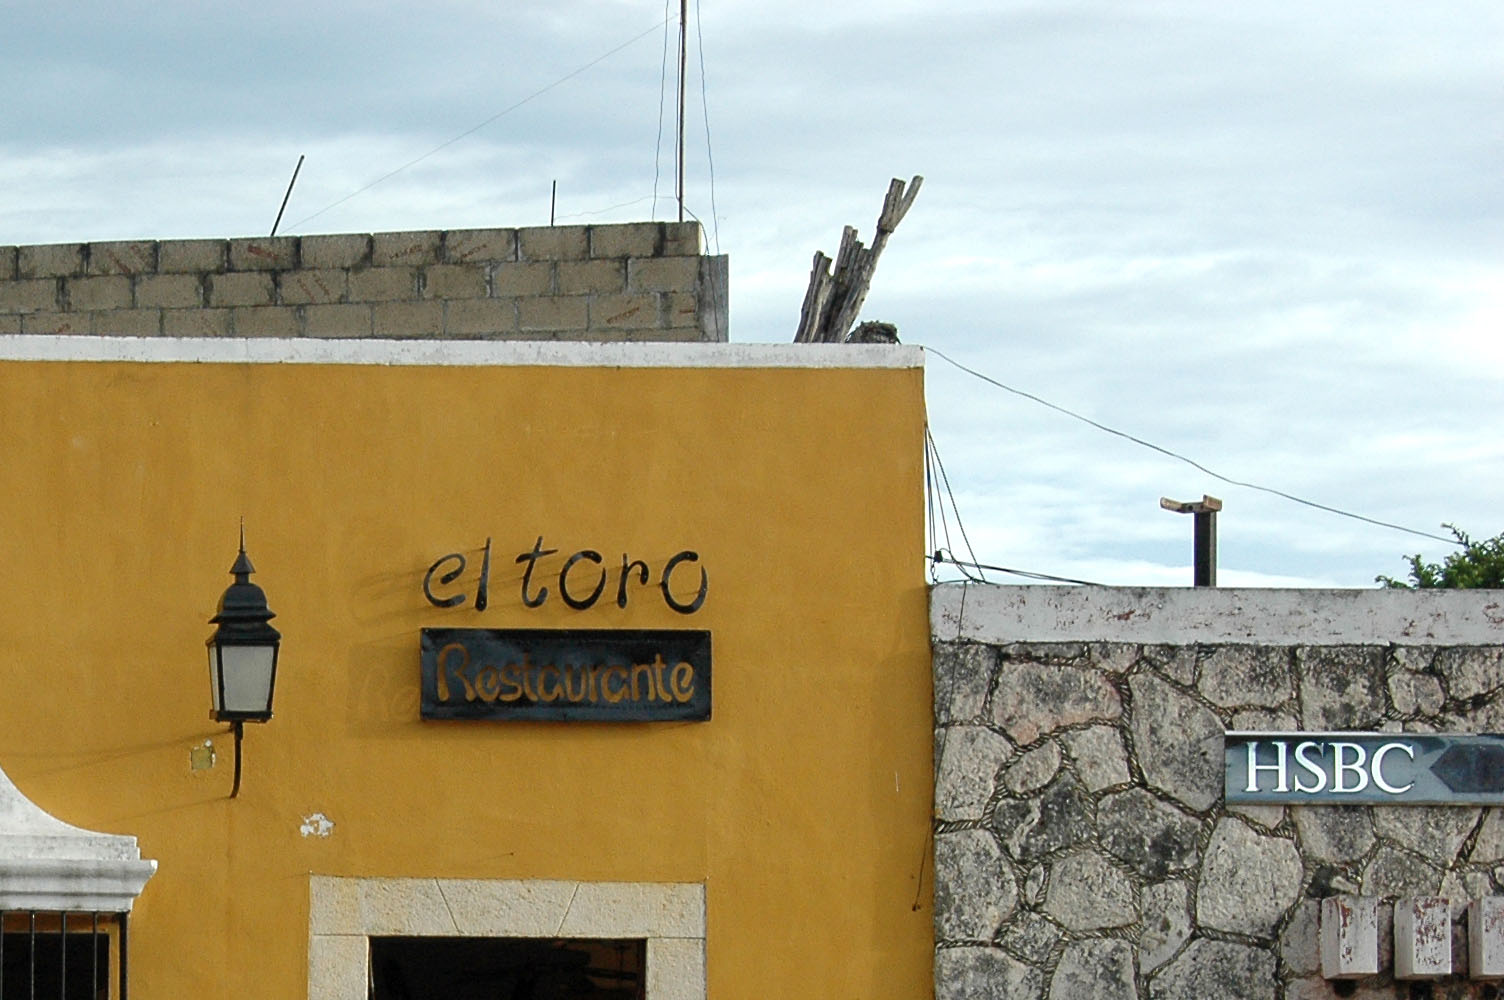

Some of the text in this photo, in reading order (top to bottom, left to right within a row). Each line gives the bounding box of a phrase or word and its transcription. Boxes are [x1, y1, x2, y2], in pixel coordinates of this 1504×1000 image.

[423, 536, 709, 614] el toro
[436, 643, 695, 703] Restaurante
[1244, 741, 1414, 794] HSBC
